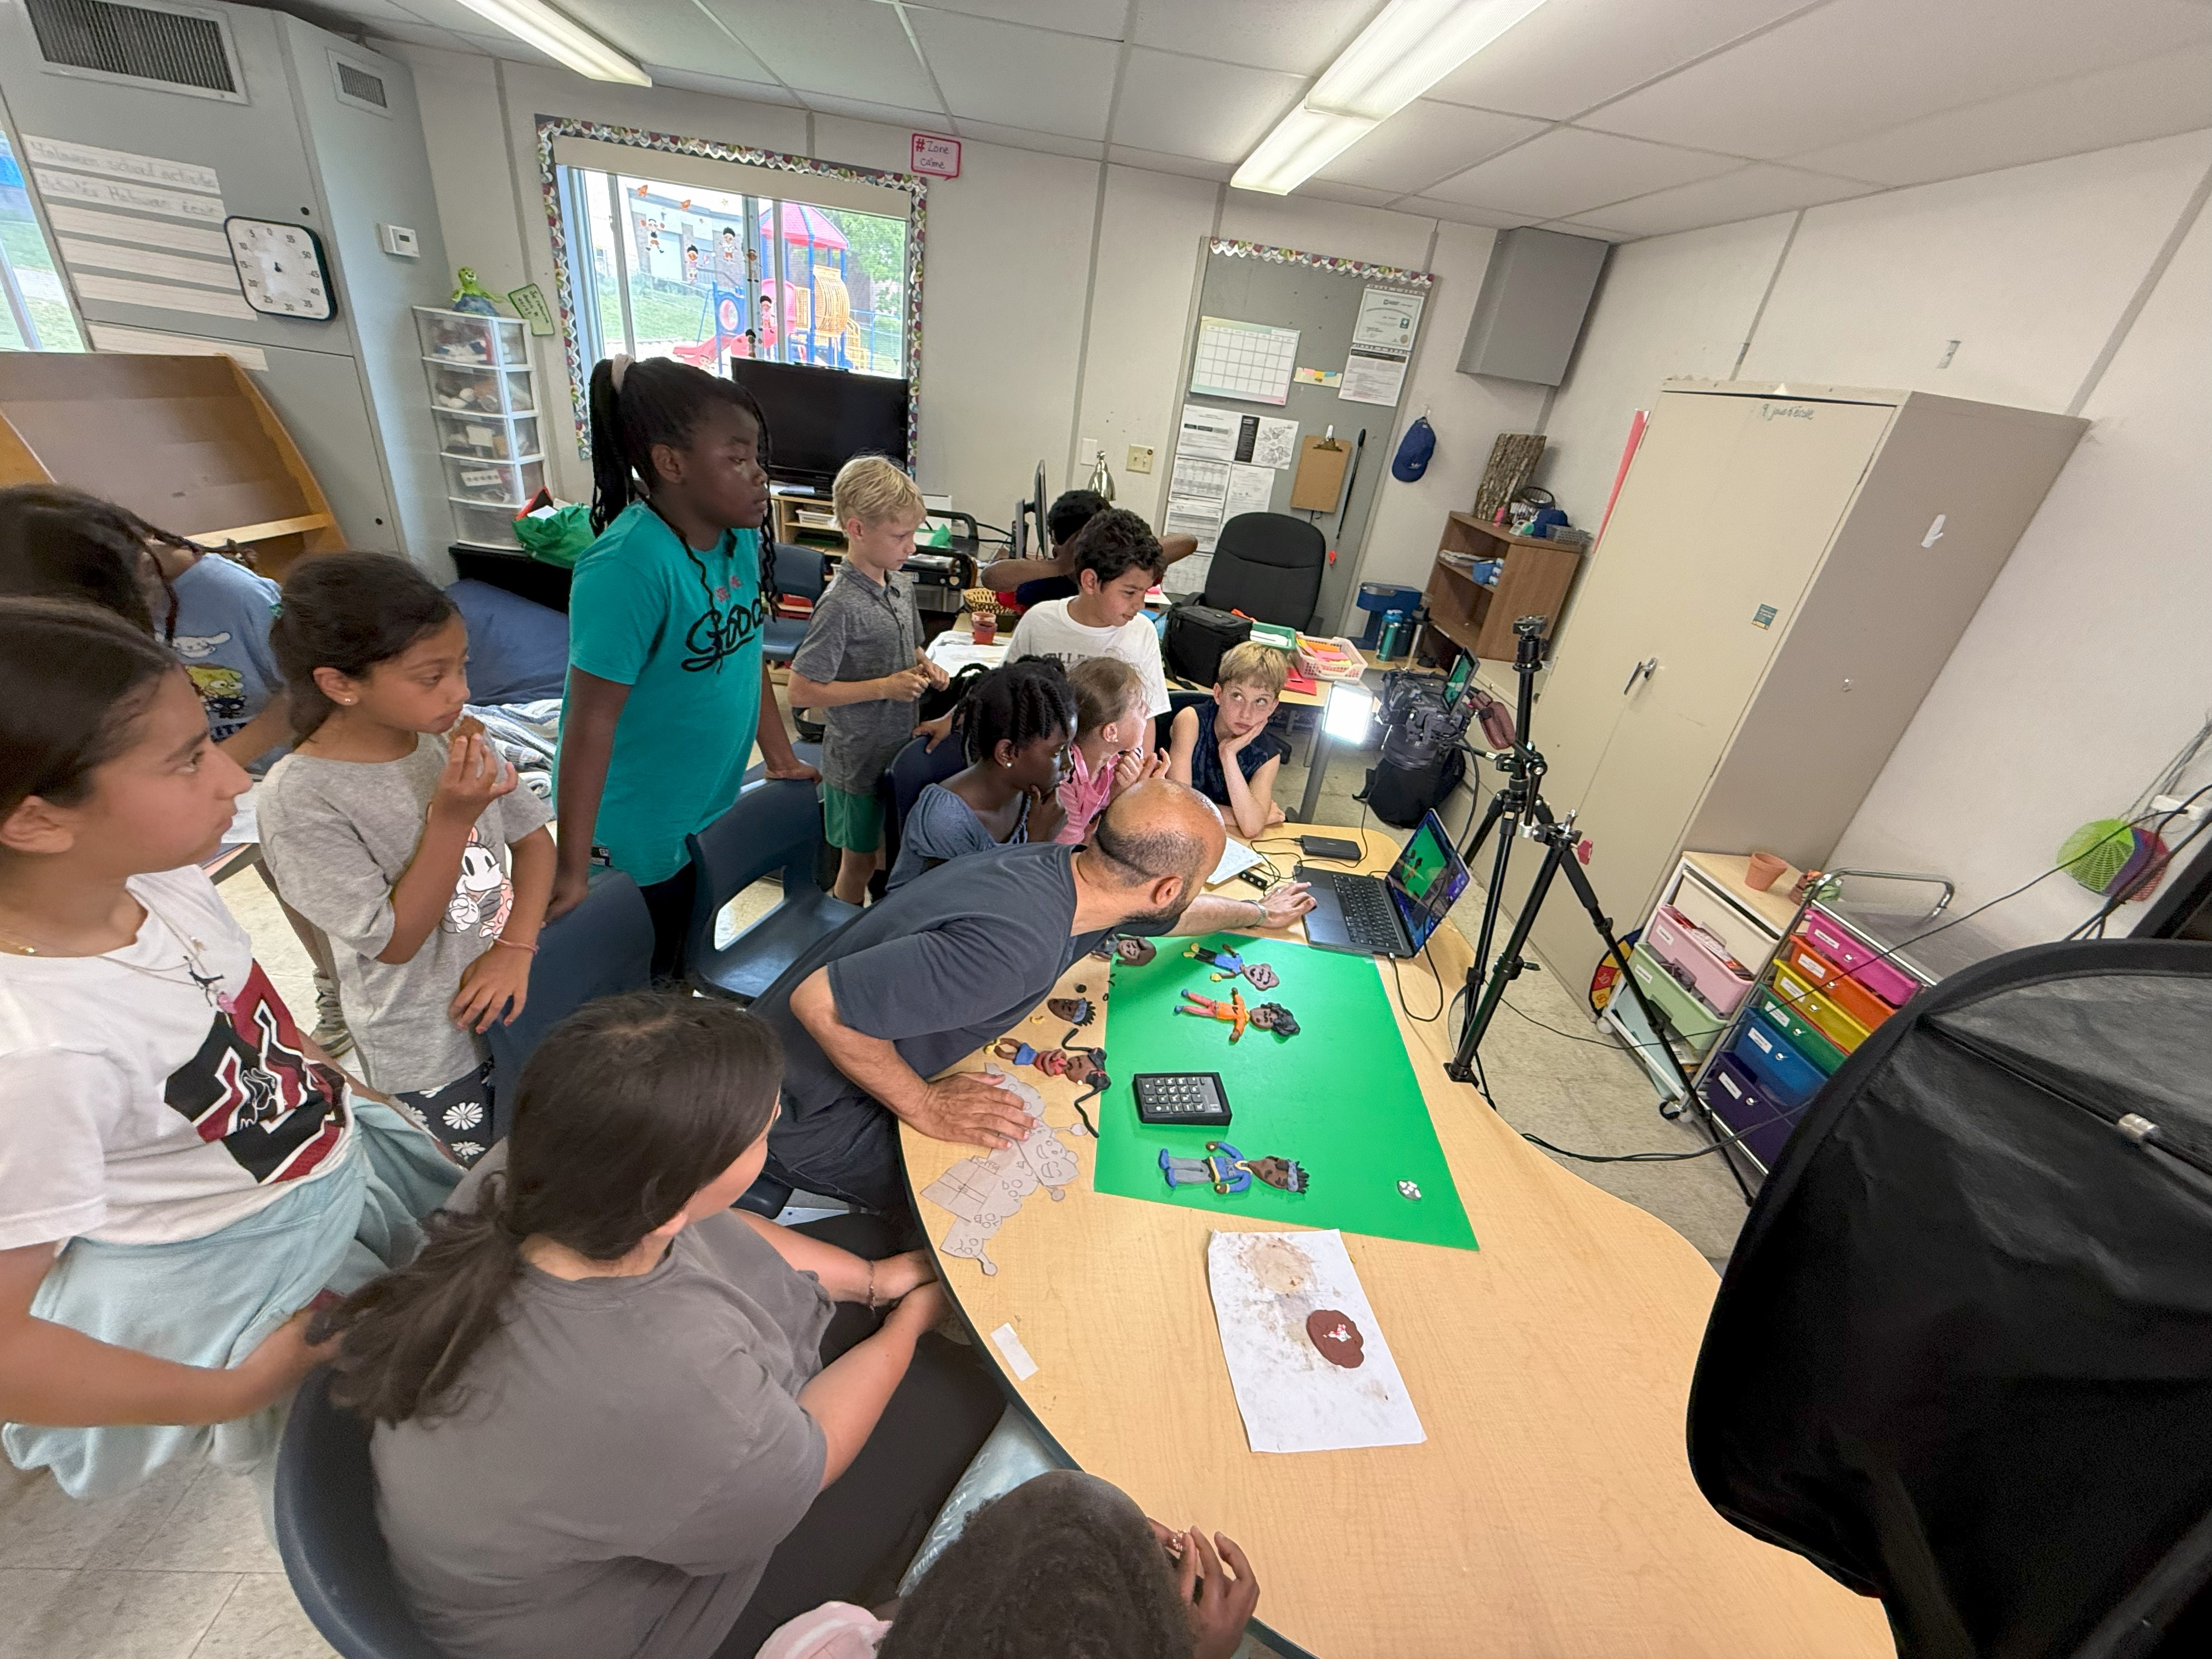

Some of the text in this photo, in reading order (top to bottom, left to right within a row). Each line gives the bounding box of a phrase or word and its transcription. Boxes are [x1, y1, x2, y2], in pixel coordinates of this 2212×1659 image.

[249, 229, 256, 238] 5
[267, 228, 273, 236] 0
[286, 234, 296, 243] 55
[302, 251, 312, 259] 50
[264, 295, 273, 303] 25
[285, 303, 295, 311] 30
[303, 300, 313, 308] 35
